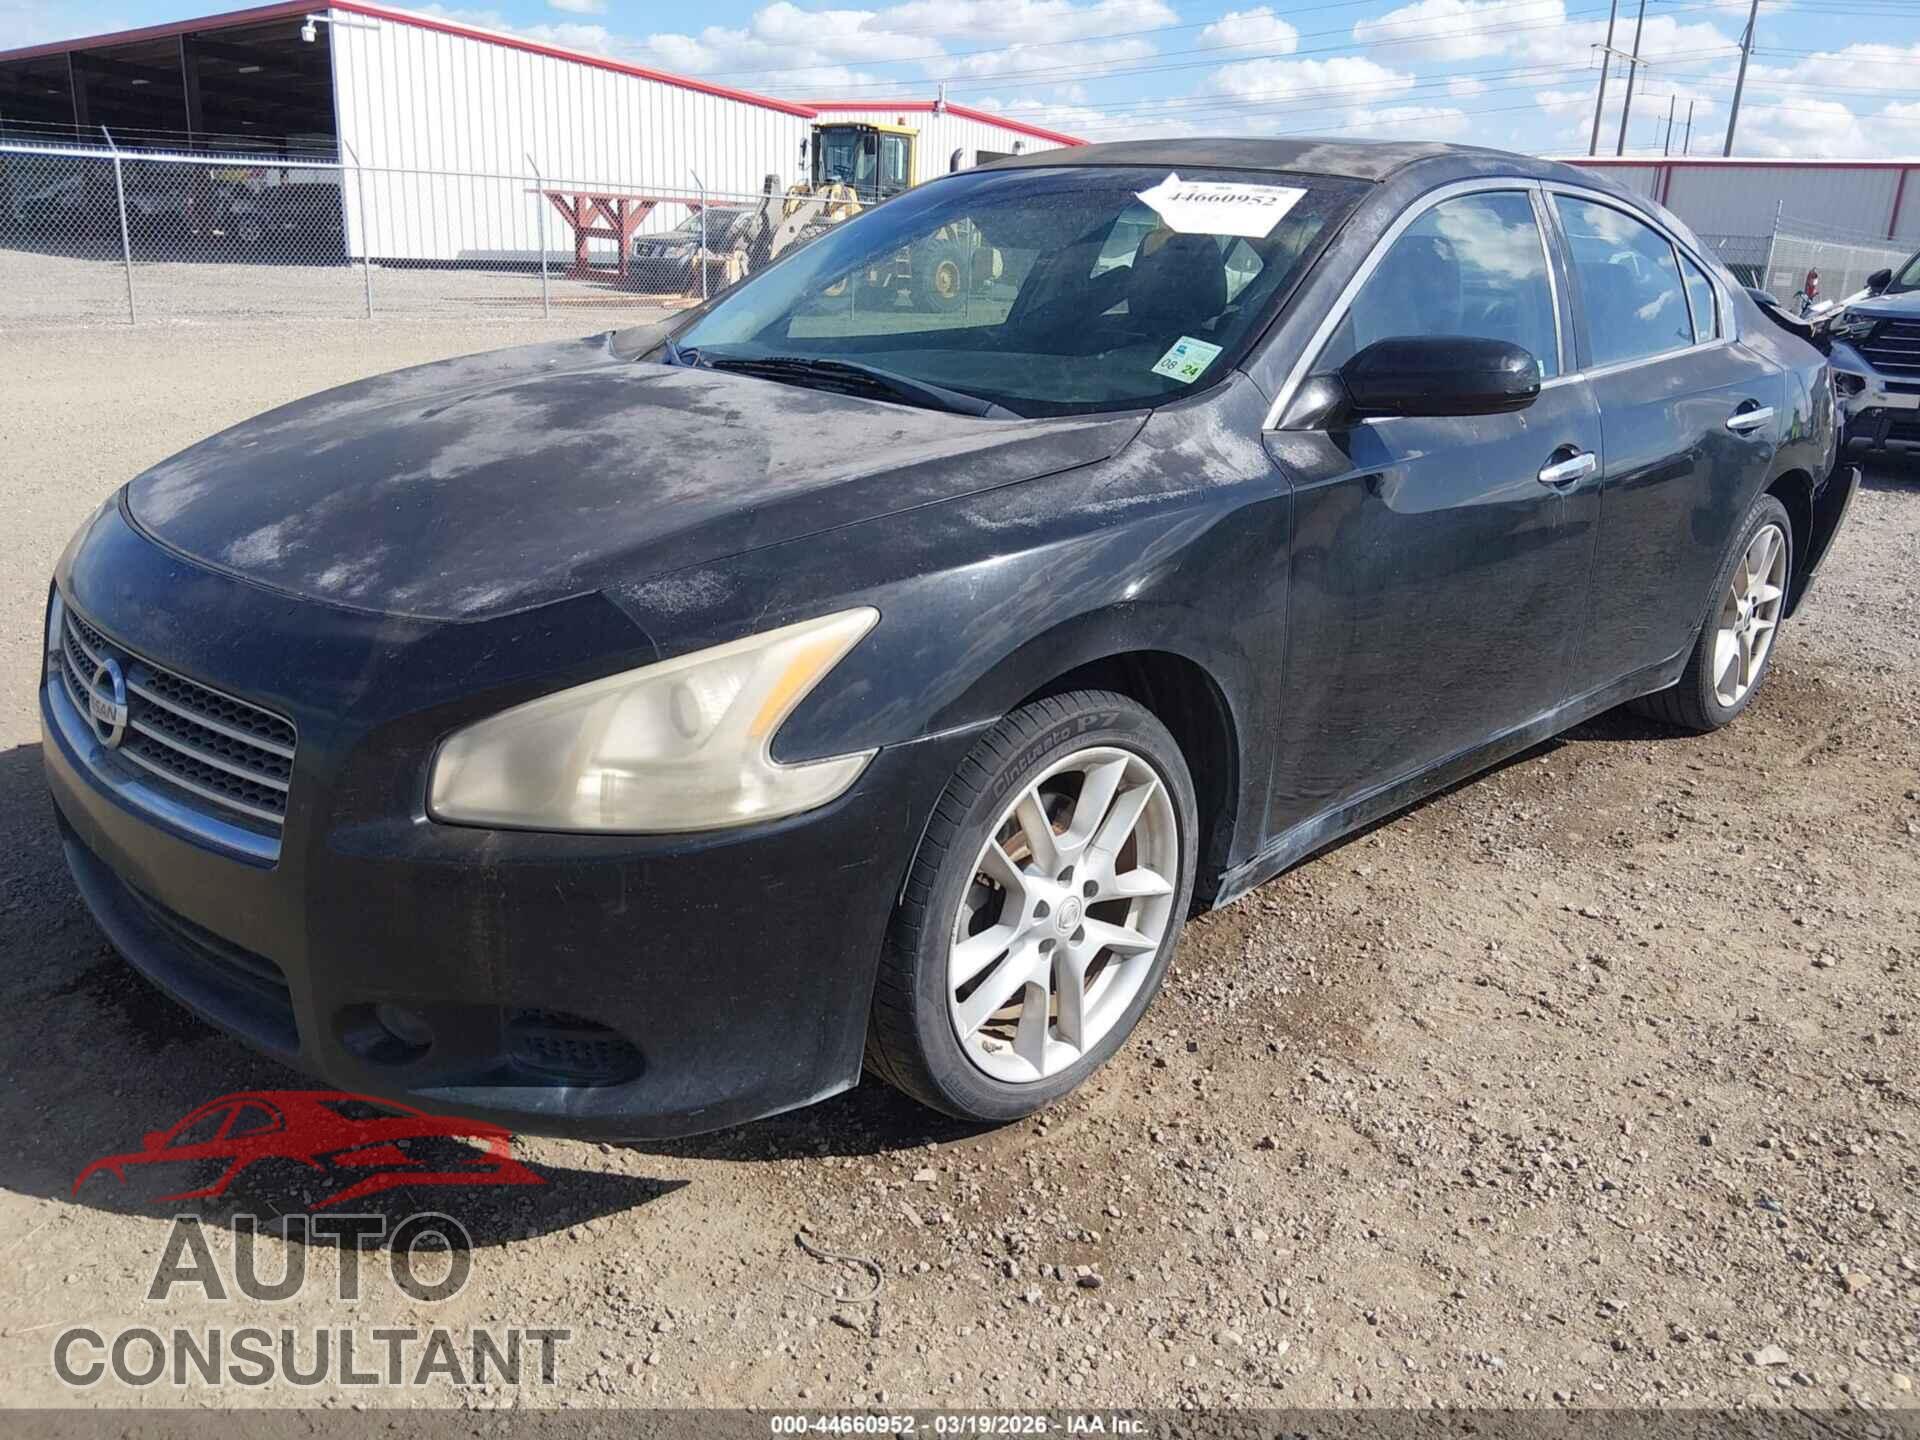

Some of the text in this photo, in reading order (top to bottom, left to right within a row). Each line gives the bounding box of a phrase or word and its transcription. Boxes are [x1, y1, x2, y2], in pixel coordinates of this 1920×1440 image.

[1161, 359, 1199, 376] 08 24
[1076, 709, 1121, 733] P7
